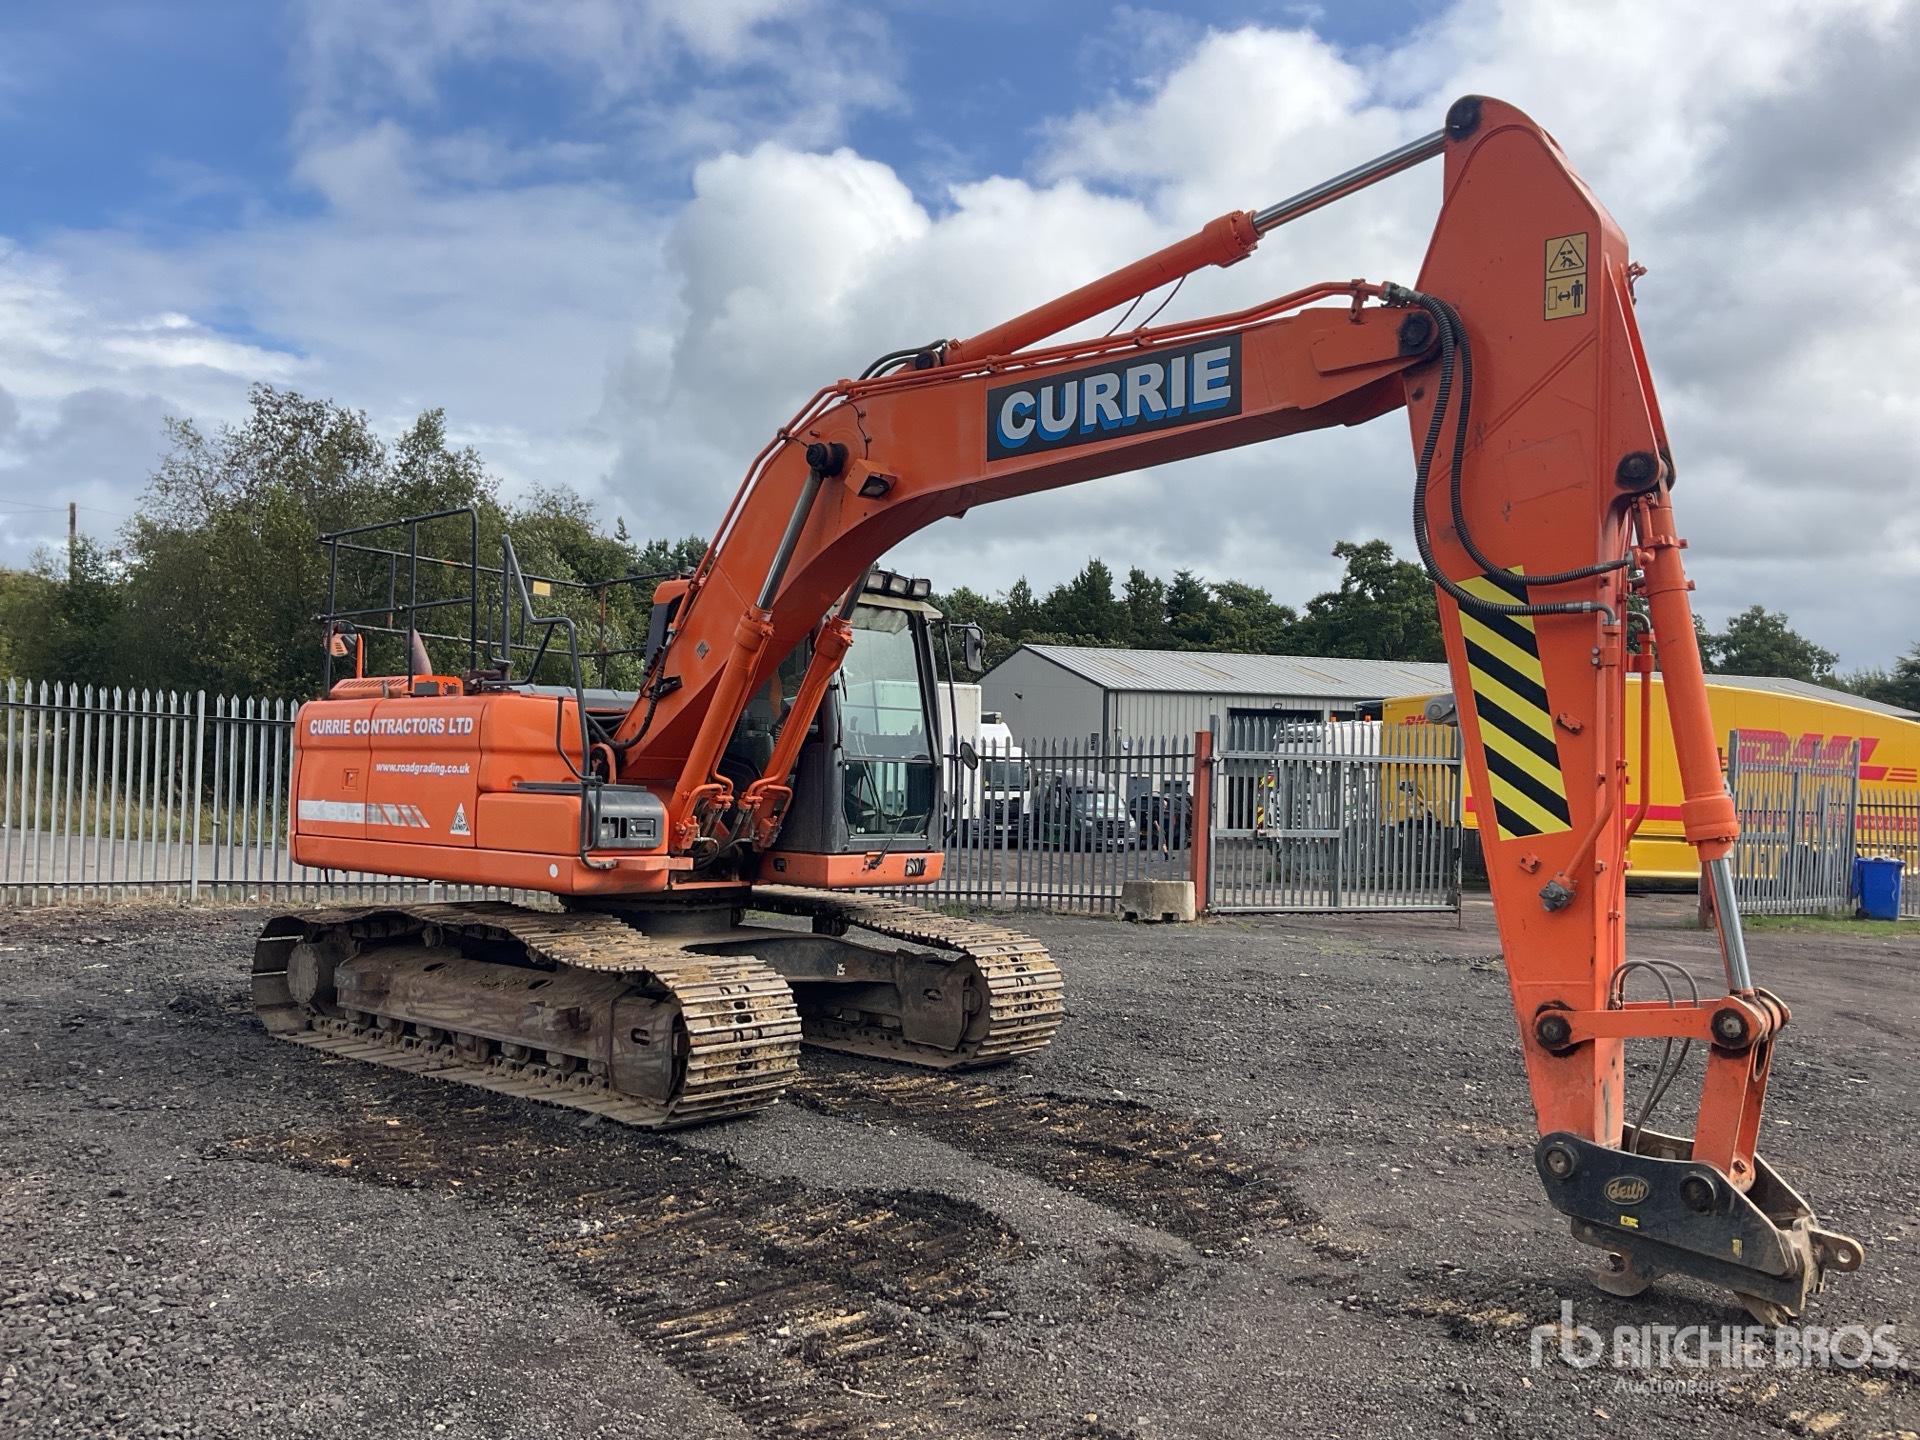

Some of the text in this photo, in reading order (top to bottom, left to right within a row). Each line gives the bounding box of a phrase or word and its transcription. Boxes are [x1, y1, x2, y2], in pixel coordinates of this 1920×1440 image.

[998, 346, 1231, 447] CURRIE
[309, 717, 474, 735] CURRIE CONTRACTORS LTD
[376, 763, 470, 775] www.roadgrading.co.uk
